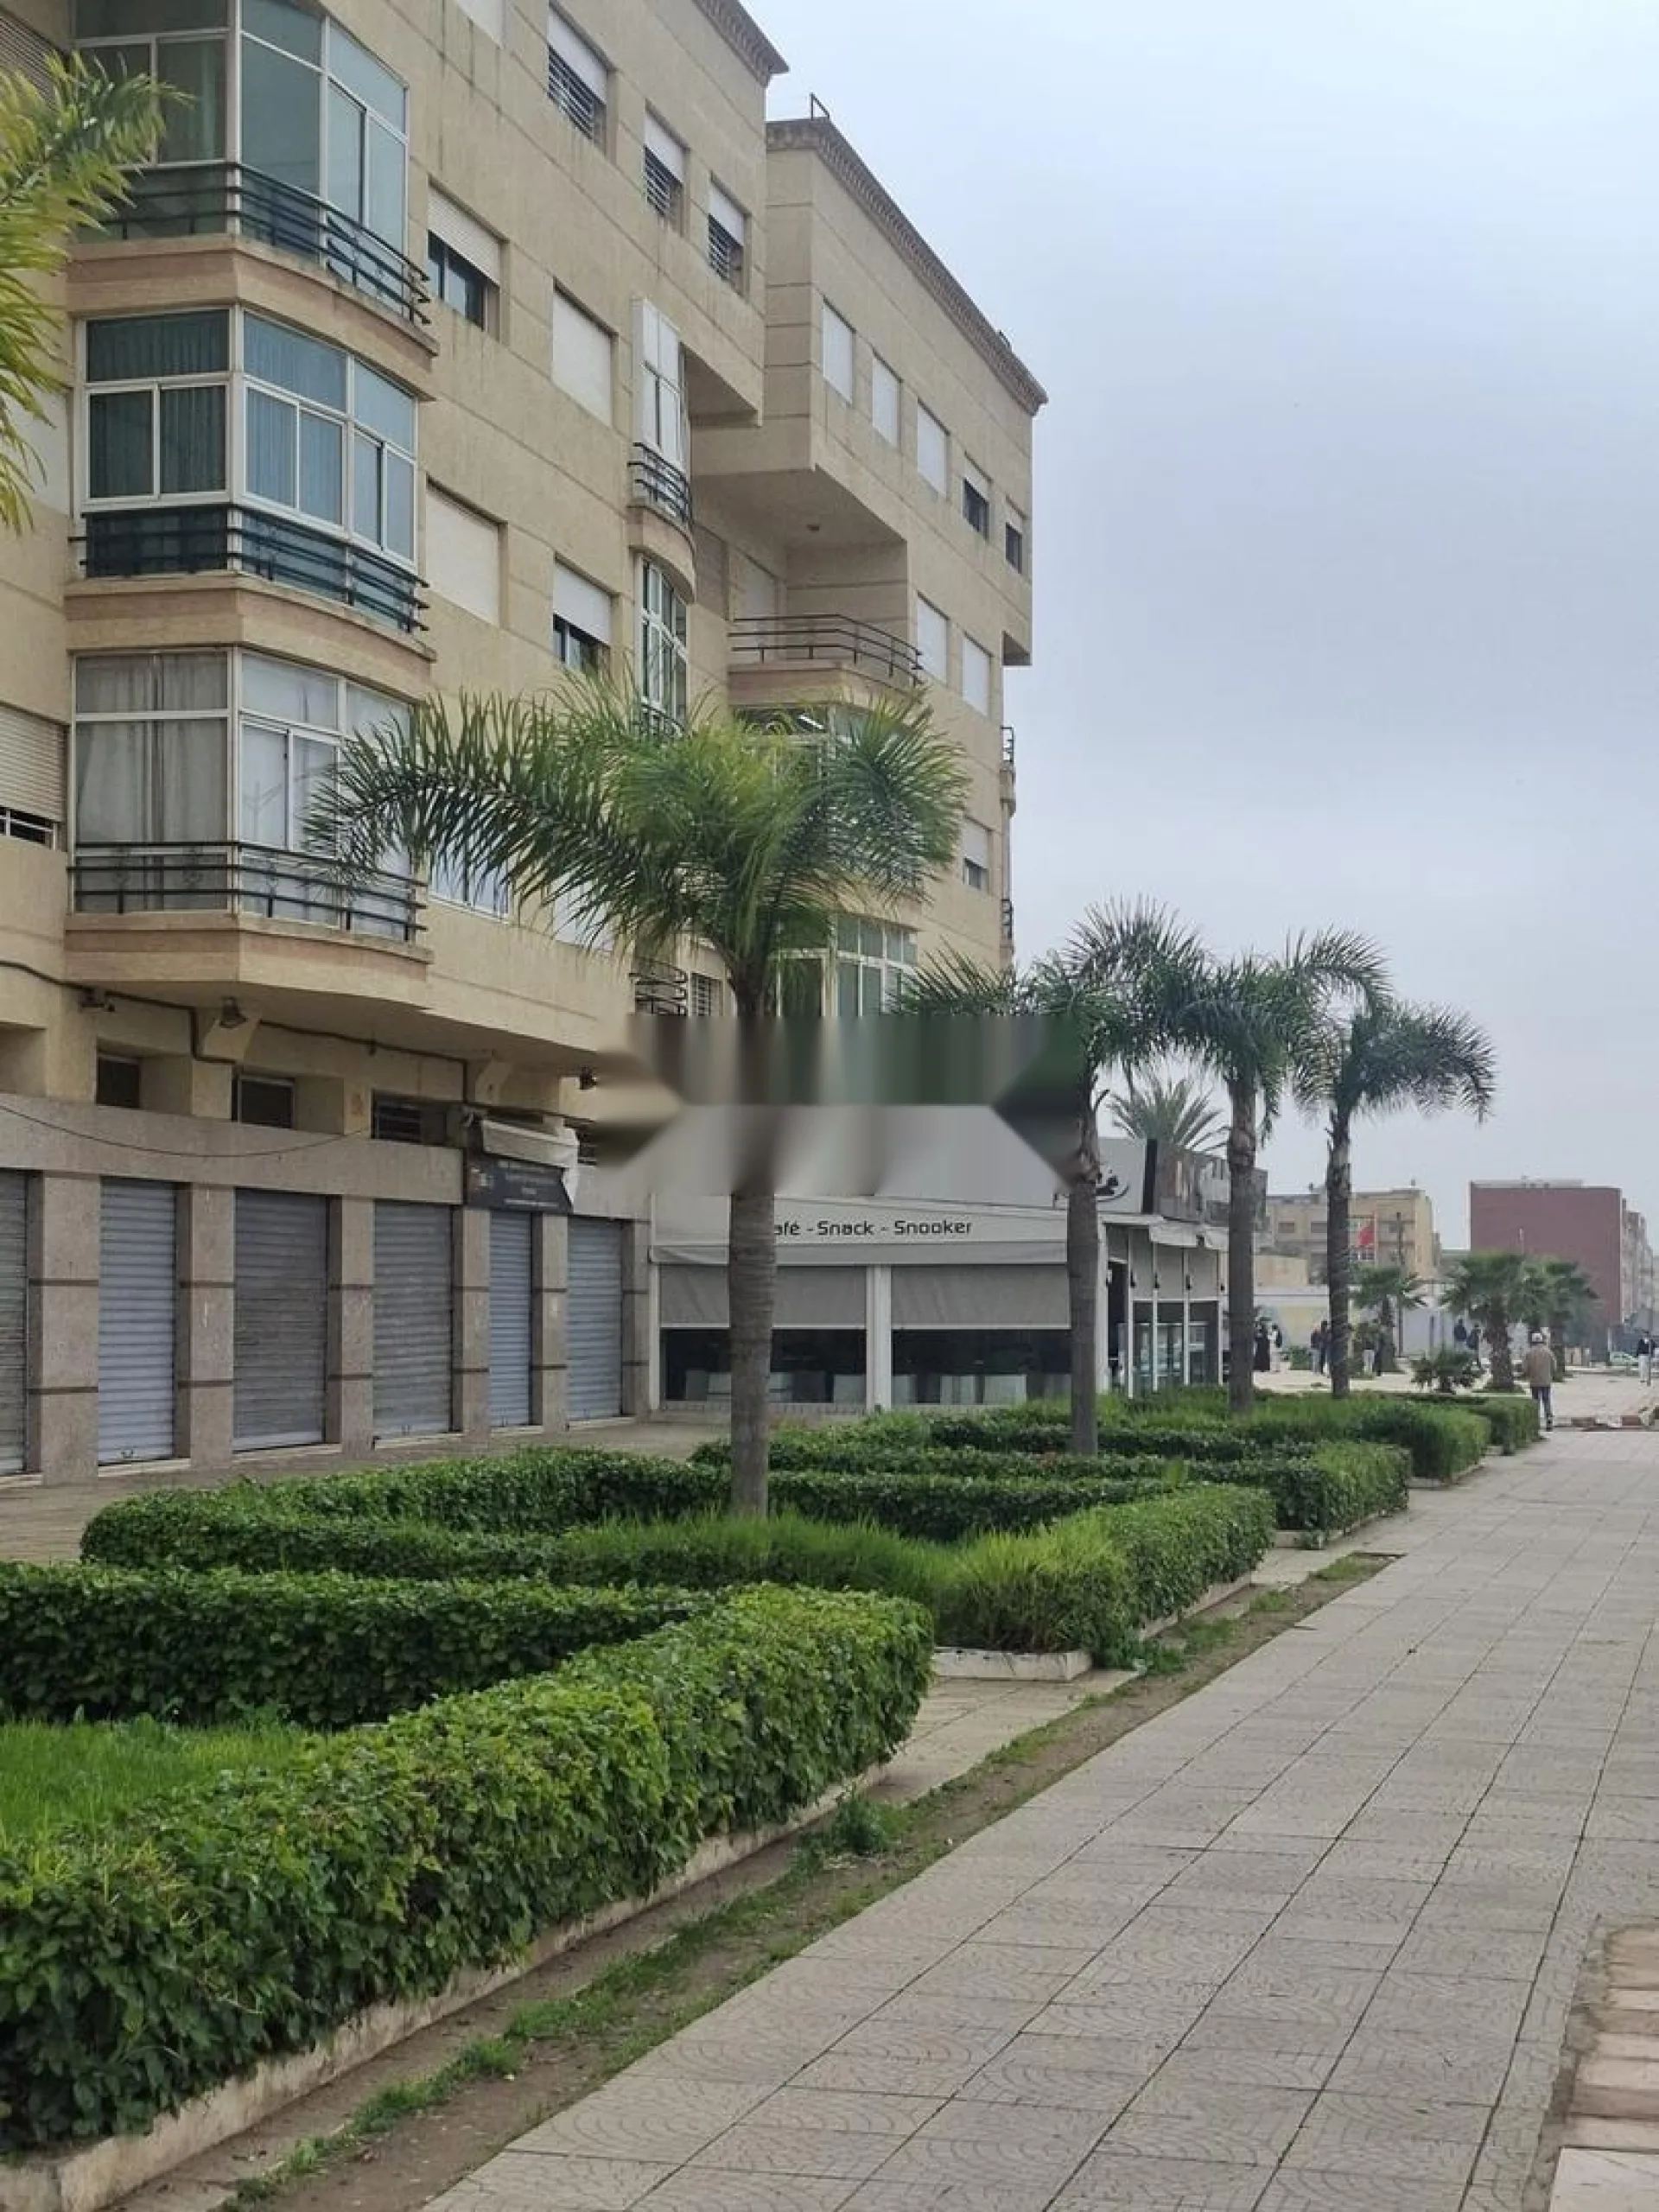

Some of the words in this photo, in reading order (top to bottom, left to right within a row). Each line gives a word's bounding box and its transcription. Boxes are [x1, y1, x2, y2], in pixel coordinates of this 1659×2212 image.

[773, 1220, 801, 1236] afé
[817, 1219, 875, 1236] Snack
[894, 1219, 972, 1236] Snooker
